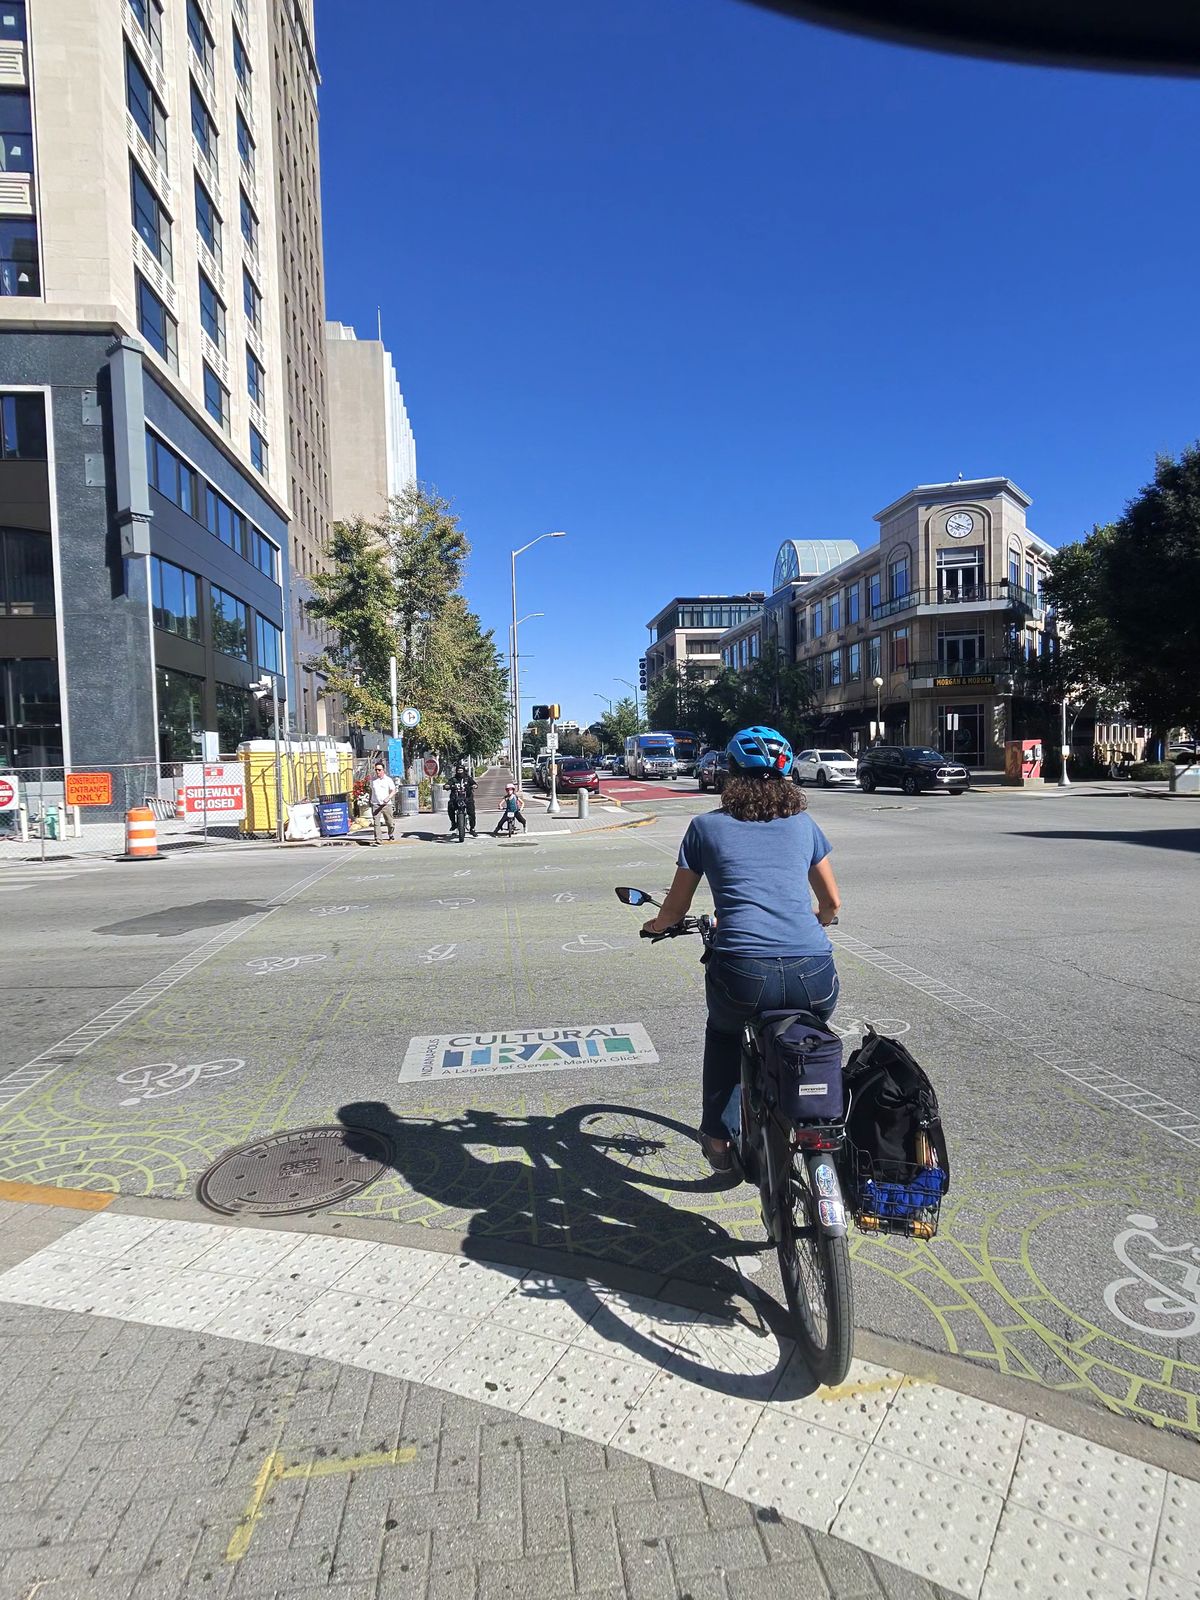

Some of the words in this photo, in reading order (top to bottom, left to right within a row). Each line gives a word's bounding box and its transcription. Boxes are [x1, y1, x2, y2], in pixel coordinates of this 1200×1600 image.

[936, 678, 960, 686] MORGAN
[968, 677, 992, 685] MORGAN
[69, 776, 106, 785] CONSTRUCTION
[70, 785, 108, 794] ENTRANCE
[186, 787, 241, 799] SIDEWALK
[76, 793, 102, 802] ONLY
[193, 798, 235, 810] CLOSED
[448, 1026, 631, 1048] CULTURAL
[442, 1037, 637, 1069] TRAIL
[455, 1066, 498, 1075] Legacy
[516, 1062, 549, 1070] Gene
[563, 1057, 608, 1067] Marilyn
[610, 1054, 640, 1063] Glick
